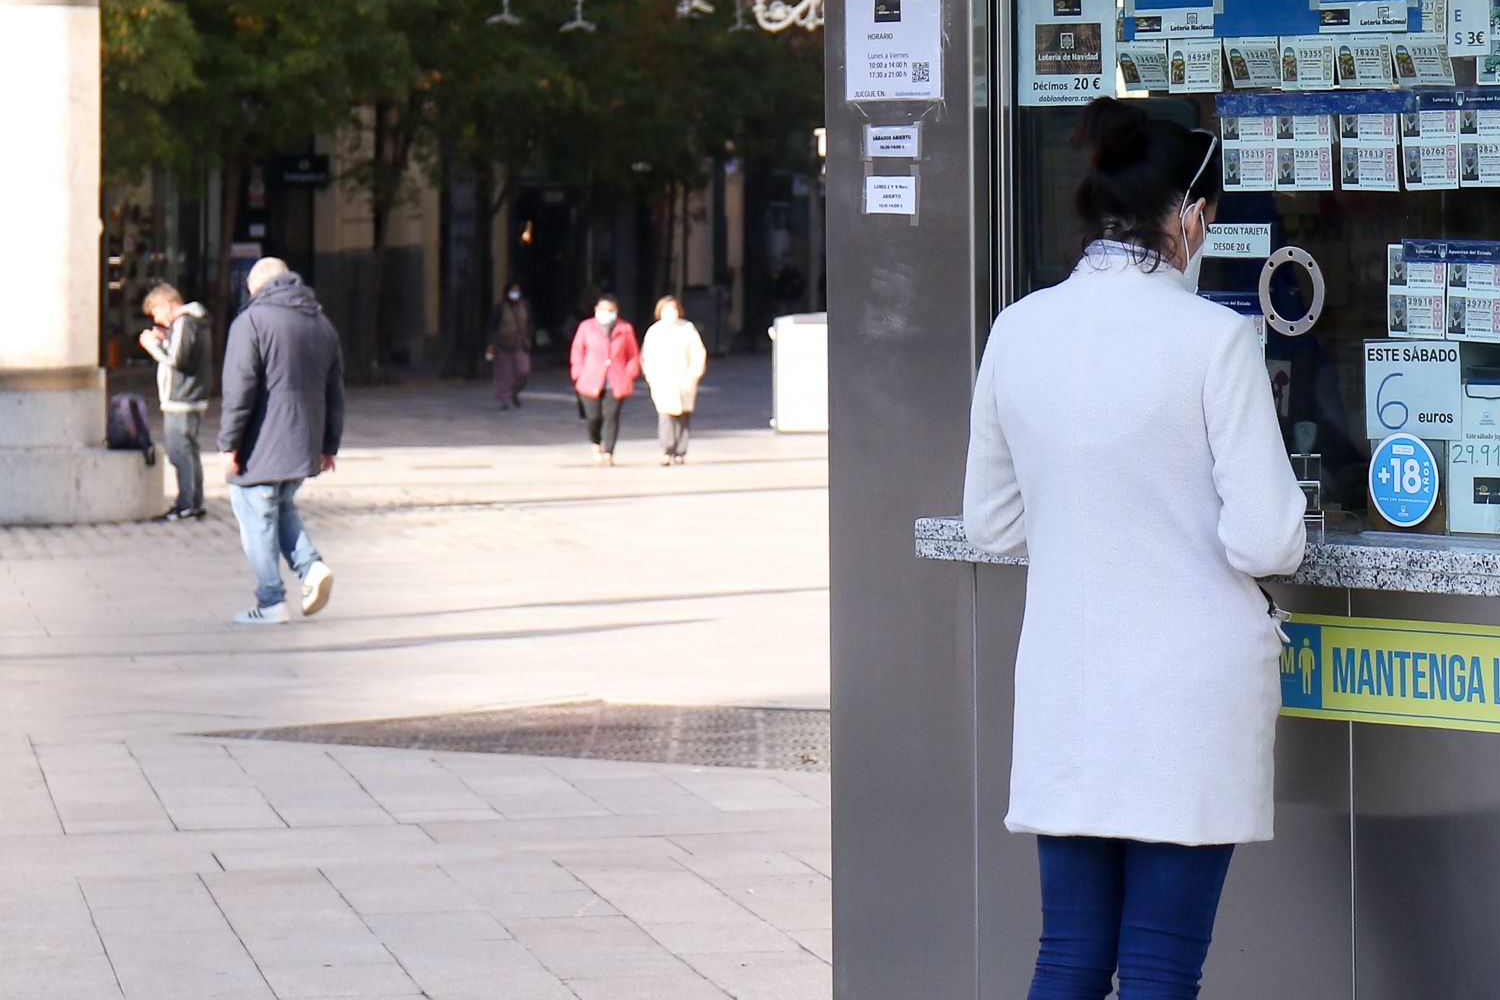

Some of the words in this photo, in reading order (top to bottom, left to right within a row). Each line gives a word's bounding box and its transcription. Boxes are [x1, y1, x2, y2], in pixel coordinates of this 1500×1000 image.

[1467, 31, 1485, 44] 3€
[1072, 52, 1099, 60] Navidad
[1033, 82, 1068, 91] Décimos
[1074, 78, 1089, 90] 20
[1093, 77, 1101, 89] €
[1367, 348, 1399, 361] ESTE
[1402, 346, 1457, 362] SÁBADO
[1376, 372, 1408, 430] 6
[1418, 412, 1453, 424] euros
[1378, 458, 1422, 494] +18
[1422, 461, 1430, 493] AÑOS
[1332, 646, 1484, 704] MANTENGA
